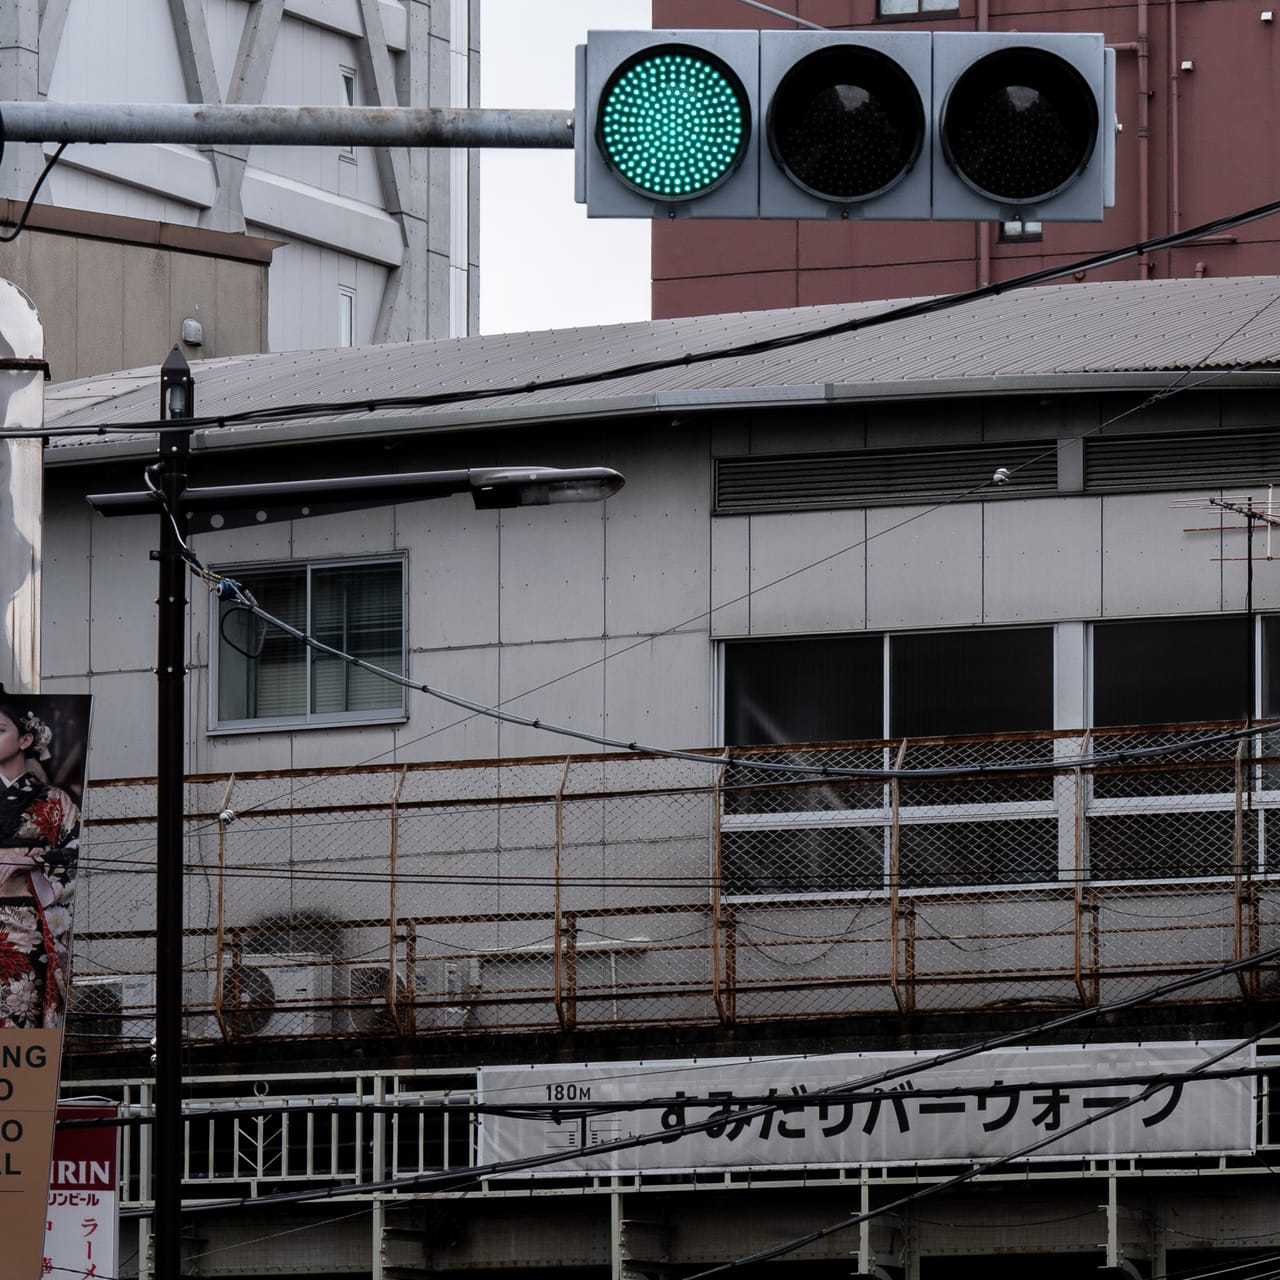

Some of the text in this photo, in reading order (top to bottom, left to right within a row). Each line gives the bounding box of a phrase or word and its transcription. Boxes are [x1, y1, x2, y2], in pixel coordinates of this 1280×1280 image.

[50, 1161, 111, 1186] IRIN
[48, 1193, 101, 1208] リンビール
